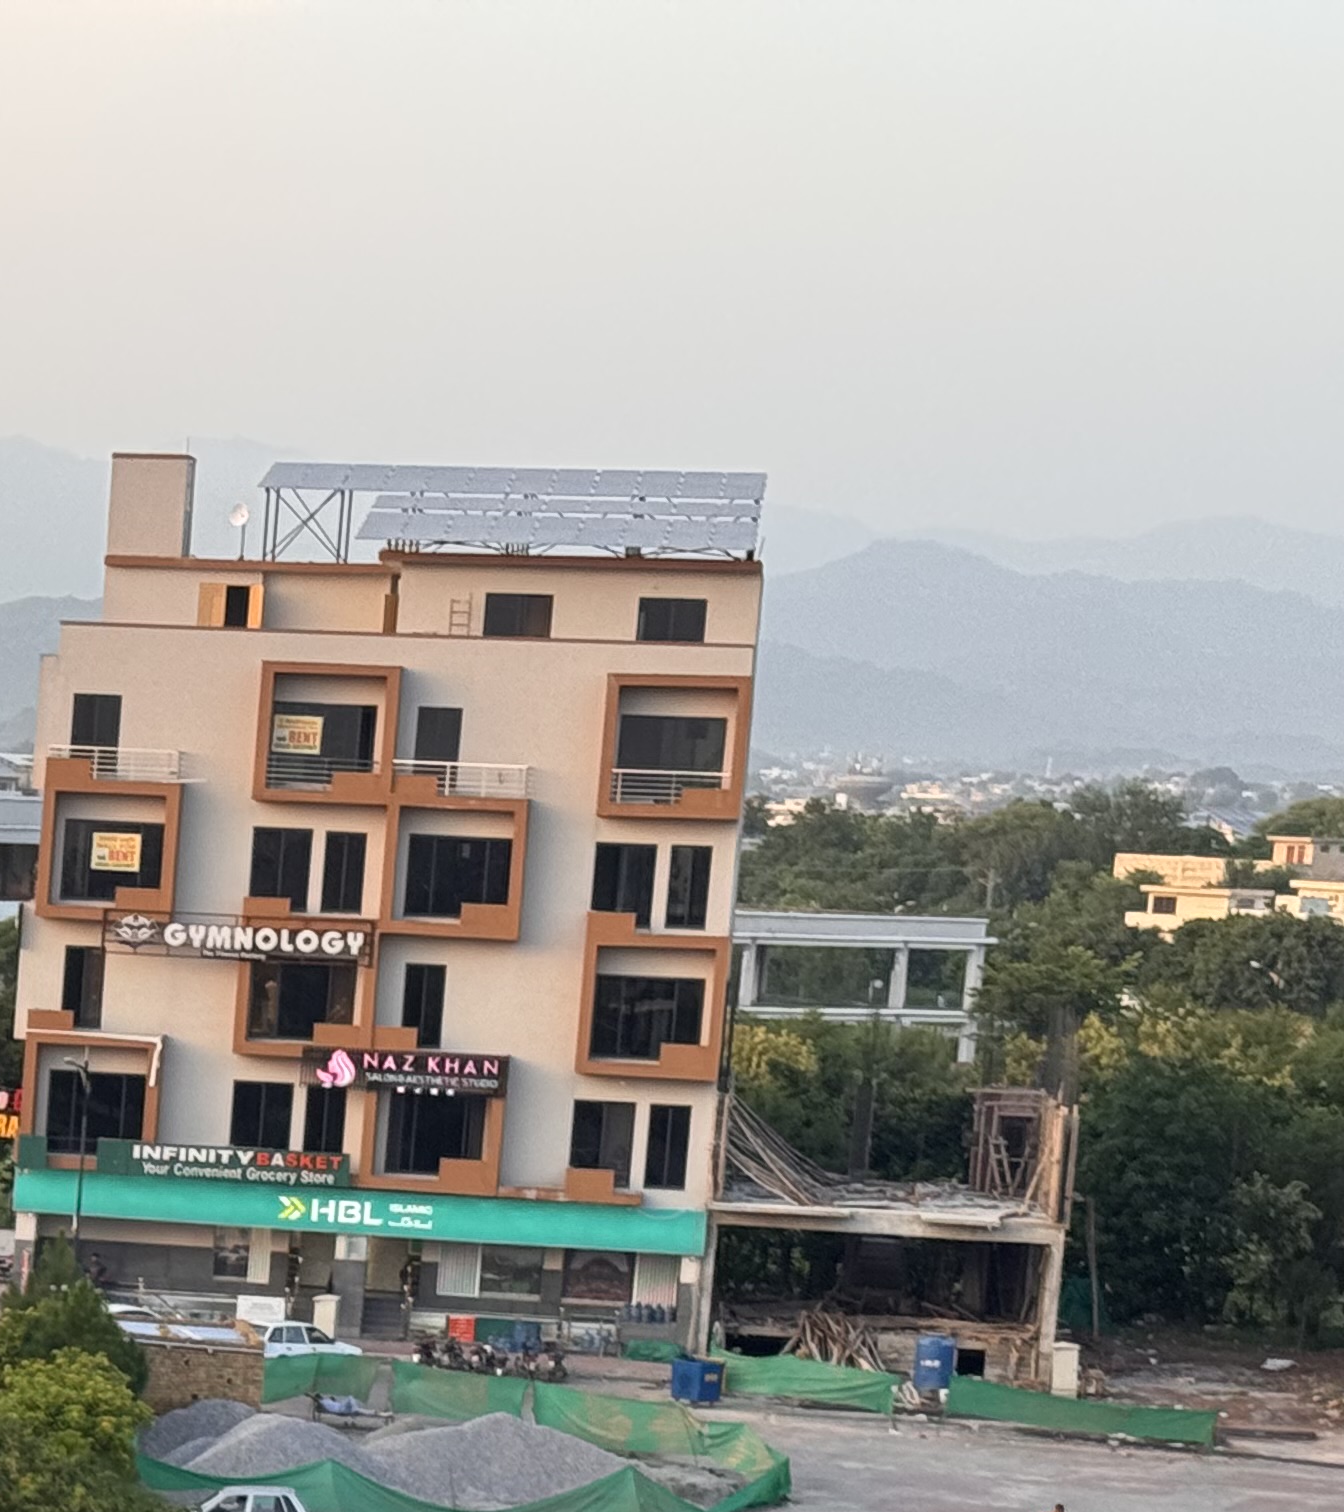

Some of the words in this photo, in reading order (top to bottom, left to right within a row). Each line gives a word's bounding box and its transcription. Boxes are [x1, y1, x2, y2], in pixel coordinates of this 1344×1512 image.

[163, 922, 364, 955] GYMNOLOGY
[363, 1052, 415, 1072] NAZ
[427, 1056, 500, 1075] KHAN
[142, 1161, 169, 1176] Your
[173, 1163, 242, 1181] Convenient
[246, 1167, 297, 1186] Grocery
[300, 1170, 336, 1185] Store
[310, 1198, 384, 1226] HBL
